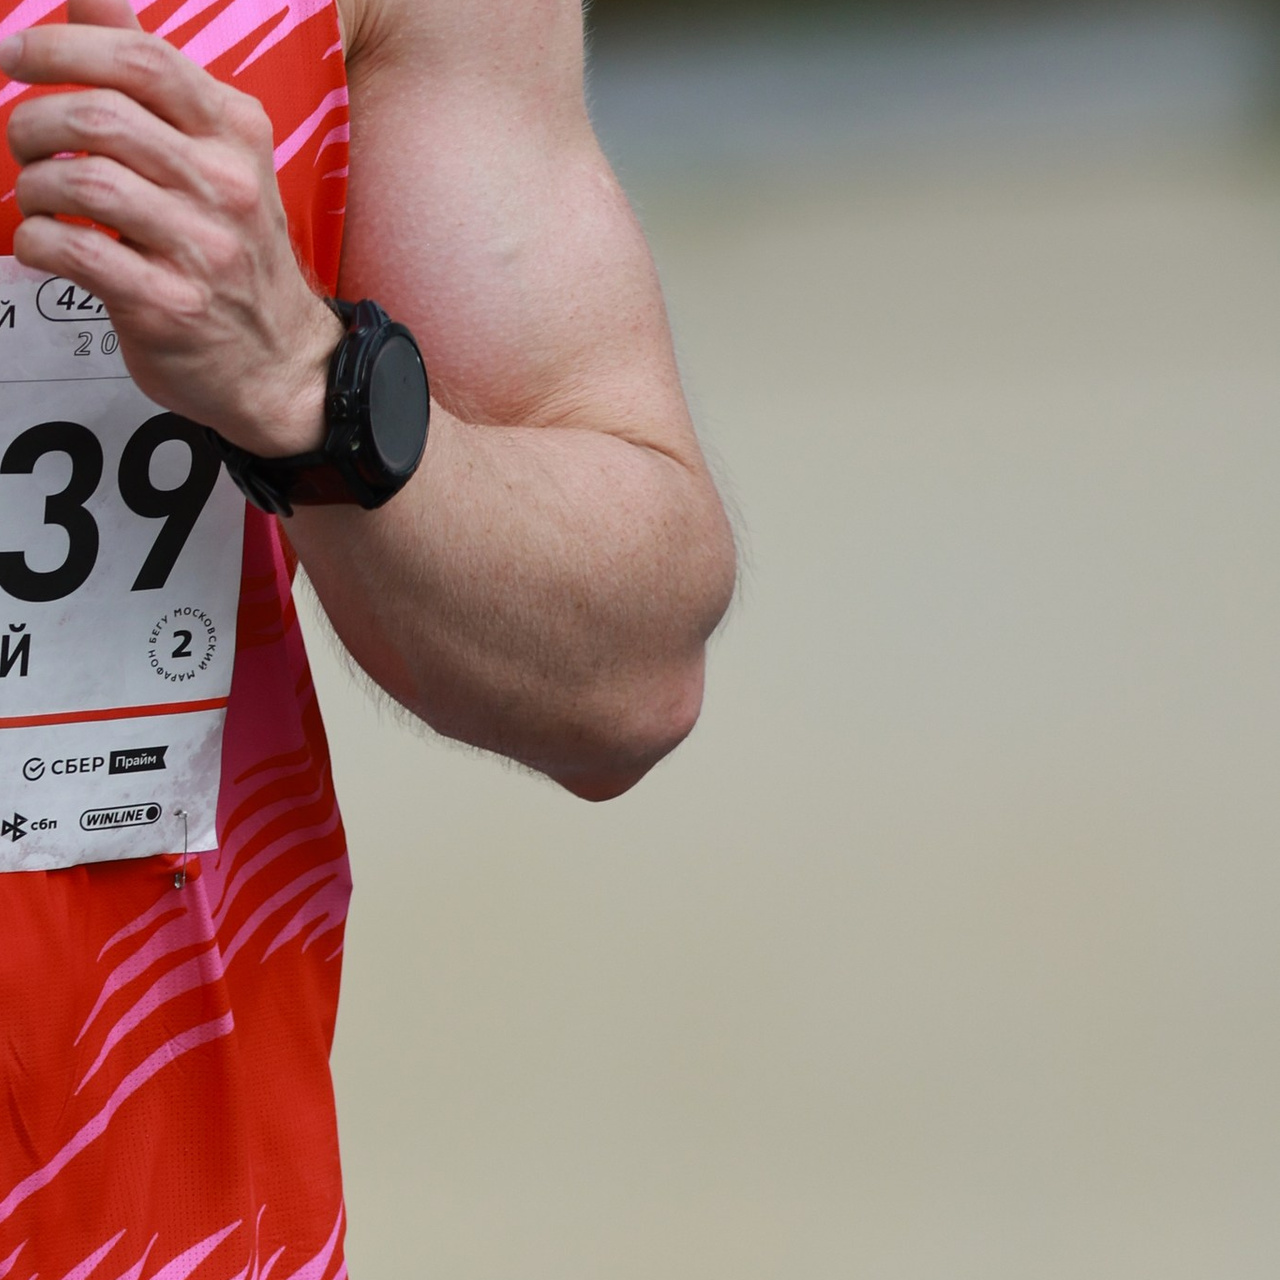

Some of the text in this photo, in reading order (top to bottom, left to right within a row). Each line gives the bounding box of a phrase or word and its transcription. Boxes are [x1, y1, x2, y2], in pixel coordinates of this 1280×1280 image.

[57, 284, 104, 314] 42,
[74, 330, 119, 356] 20
[148, 607, 217, 682] БЕГУ МОСКОВСКИЙ МАРАФОН
[171, 630, 192, 659] 2
[51, 753, 157, 775] СБЕР Прайм
[31, 818, 57, 831] сбп
[86, 808, 145, 826] WINLINE
